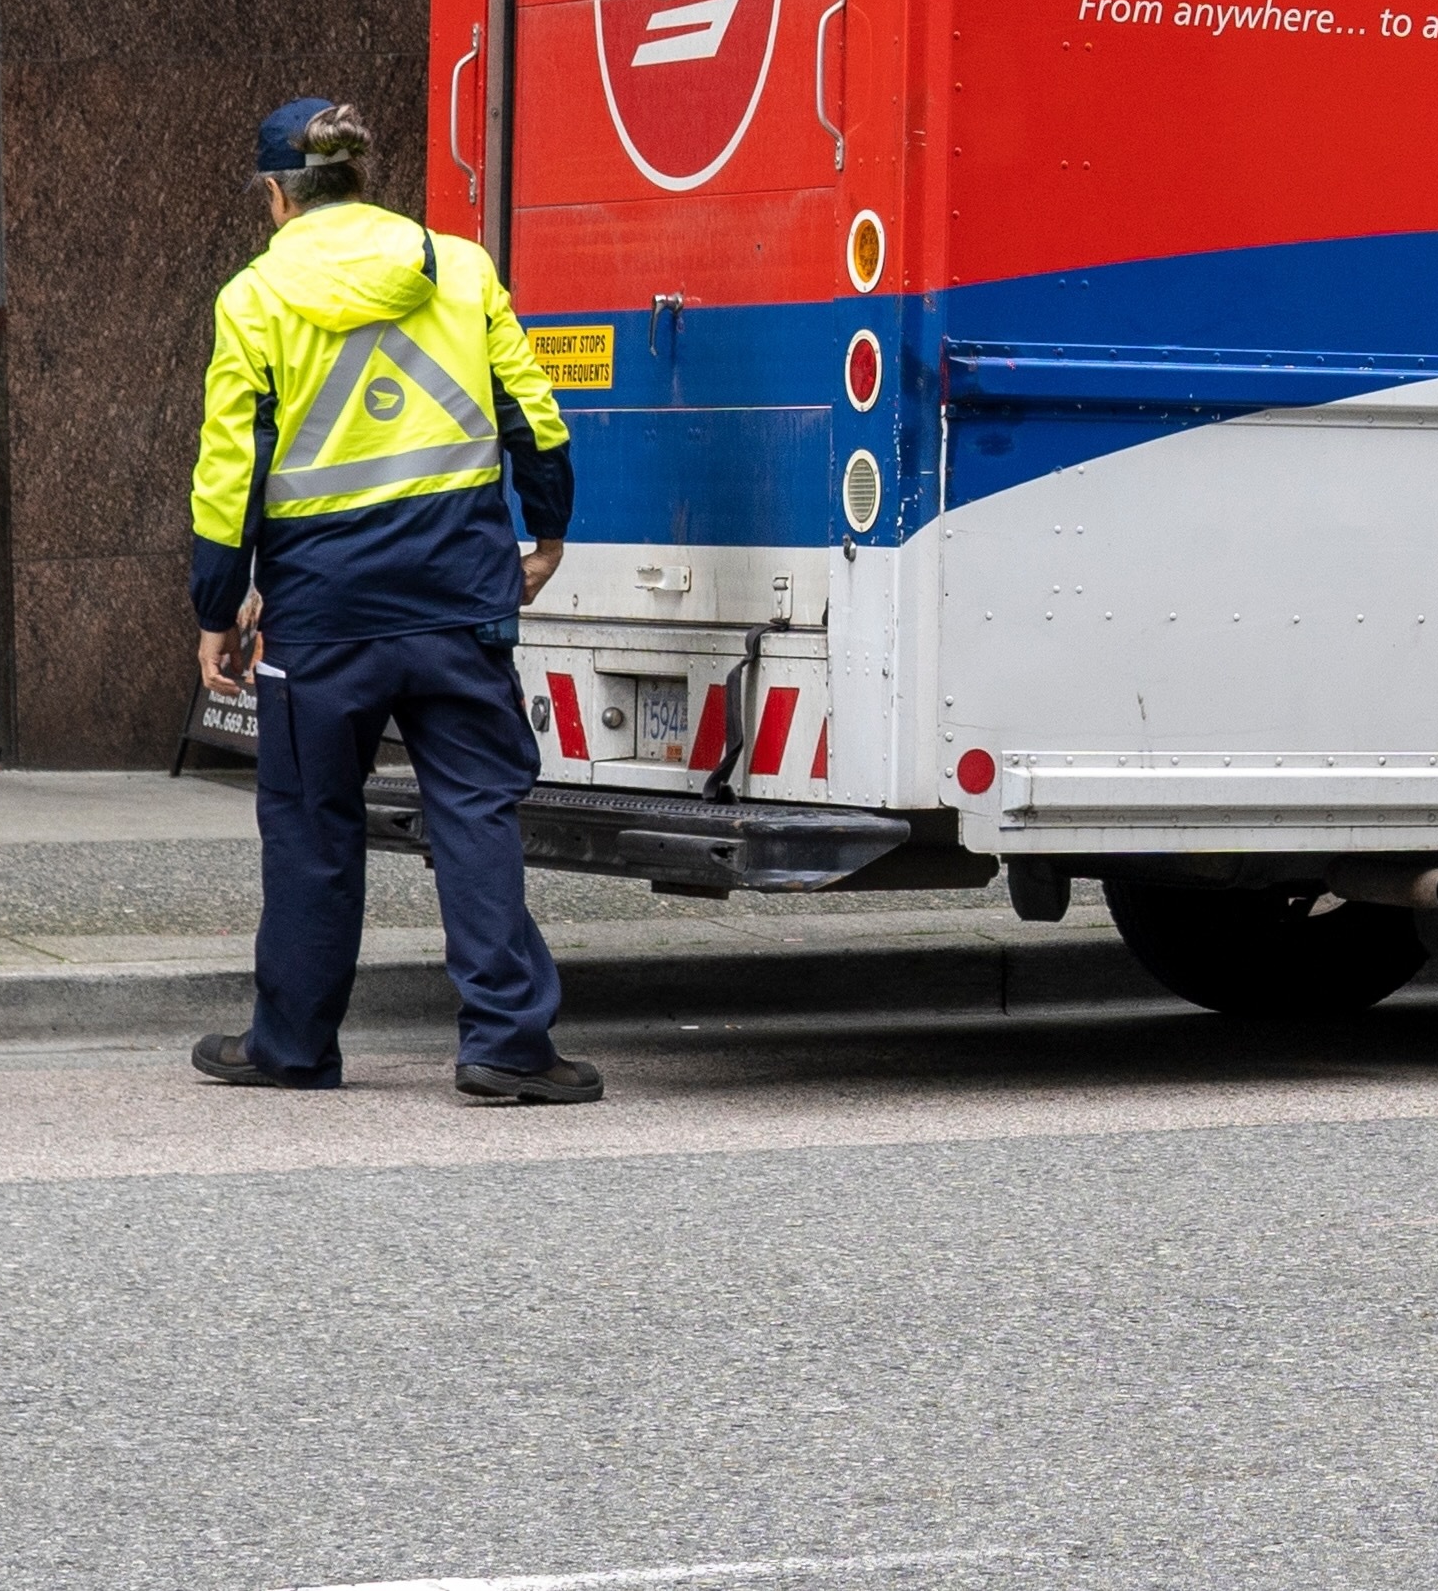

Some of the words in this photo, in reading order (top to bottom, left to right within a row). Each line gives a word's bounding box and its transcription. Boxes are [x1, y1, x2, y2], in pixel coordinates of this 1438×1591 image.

[1380, 7, 1413, 38] to
[535, 336, 577, 356] FREQUENT
[579, 334, 606, 353] STOPS
[562, 359, 610, 384] FRÉQUENTS
[202, 708, 258, 737] 604.669.33
